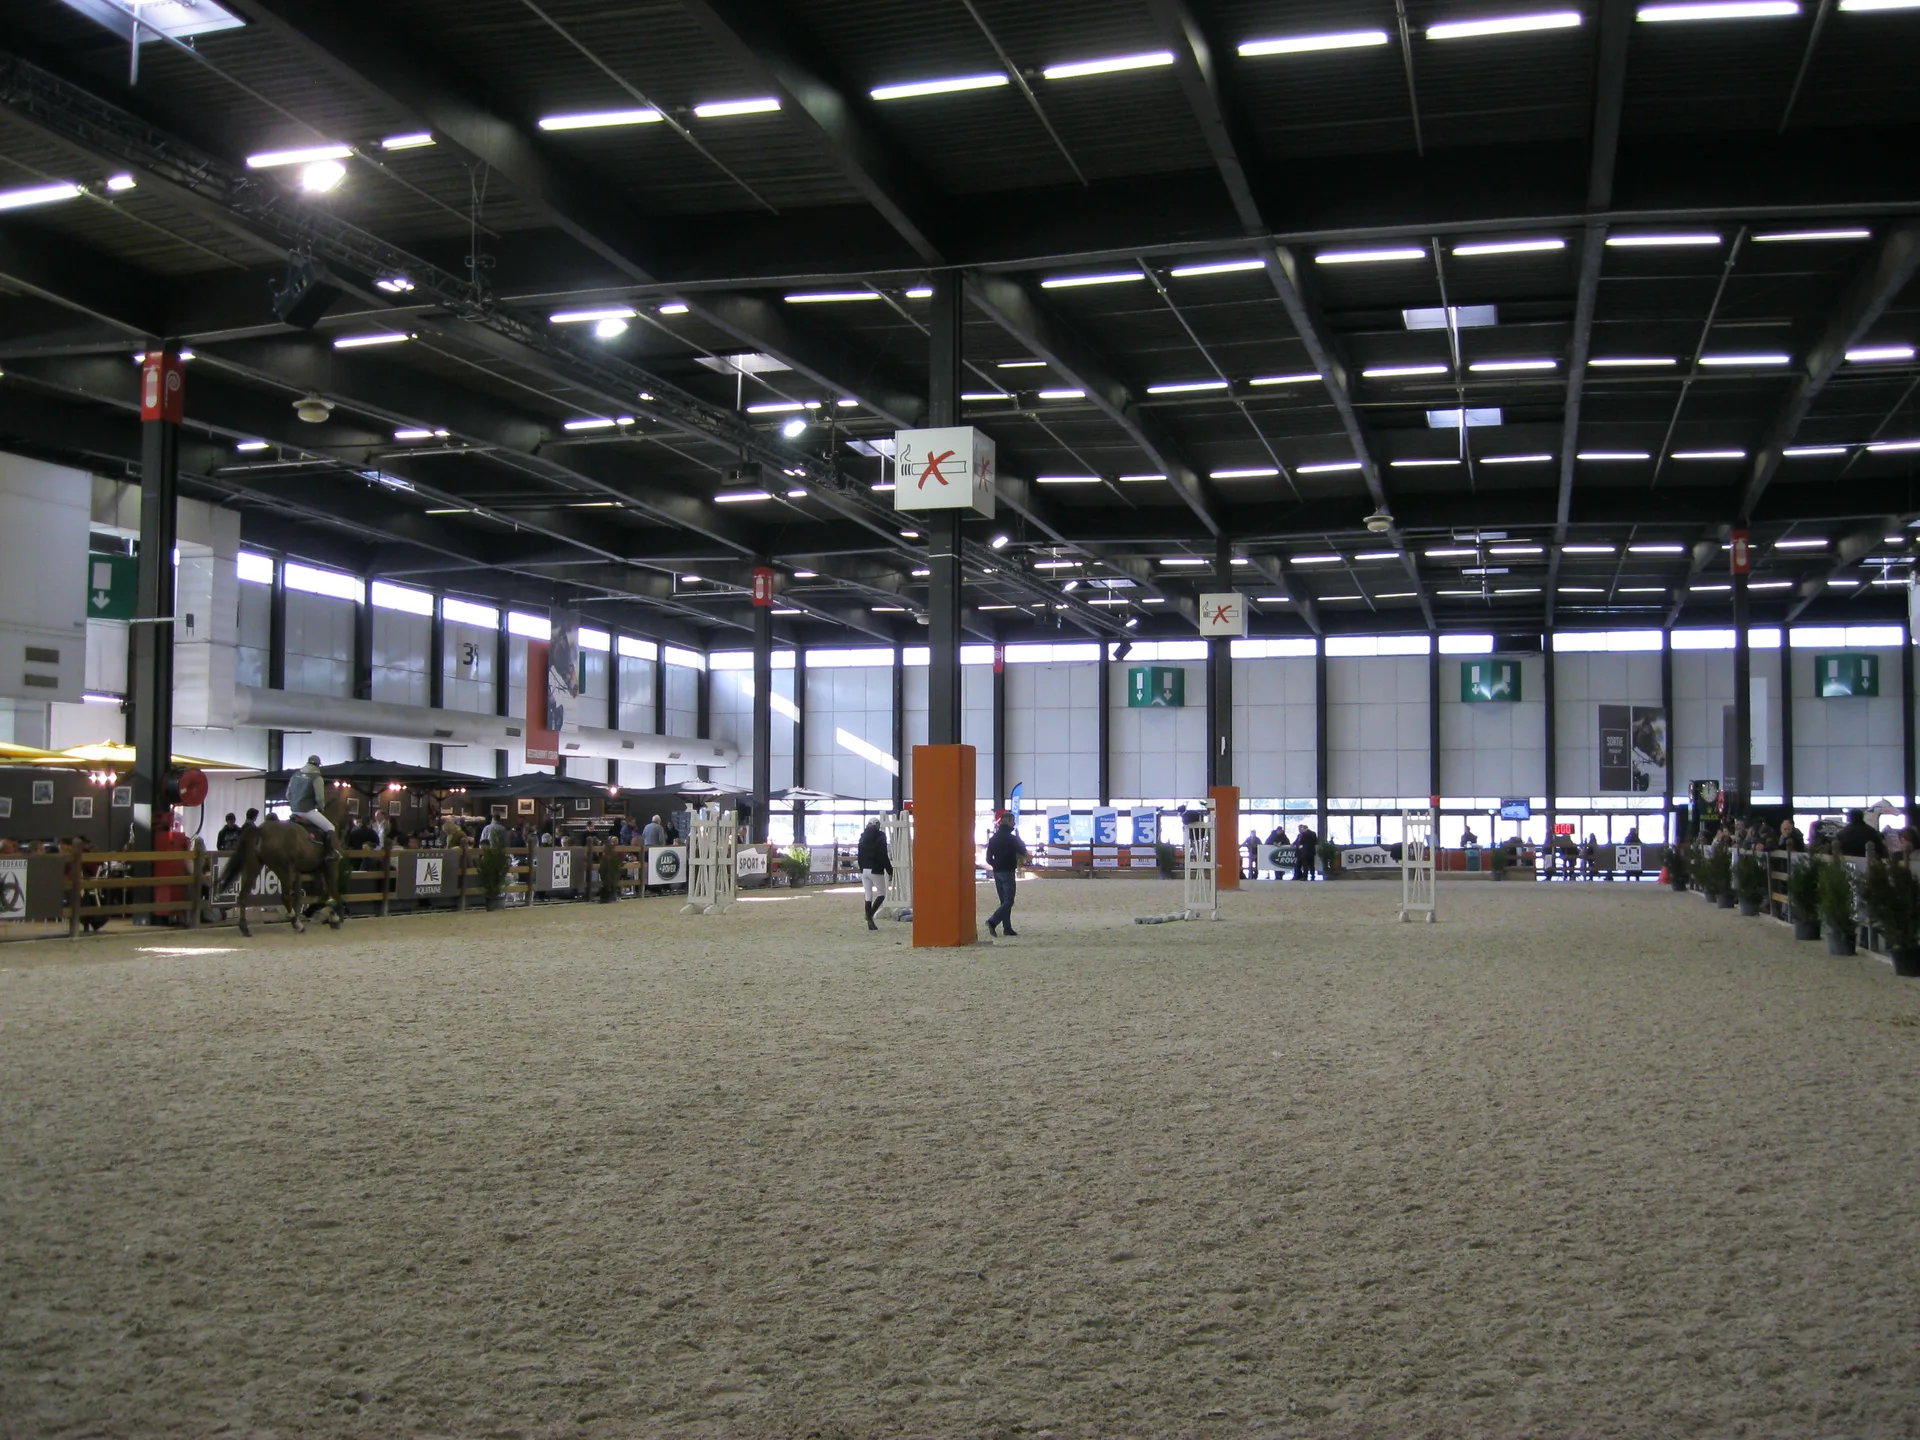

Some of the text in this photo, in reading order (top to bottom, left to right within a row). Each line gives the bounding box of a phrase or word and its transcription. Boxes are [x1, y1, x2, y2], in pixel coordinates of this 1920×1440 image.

[1053, 823, 1071, 845] 3
[1099, 822, 1116, 844] 3
[1138, 822, 1155, 844] 3
[660, 855, 674, 865] LAND
[739, 857, 759, 869] SPORT
[1347, 853, 1387, 864] SPORT
[1617, 846, 1640, 865] 20
[661, 864, 677, 873] ROVER
